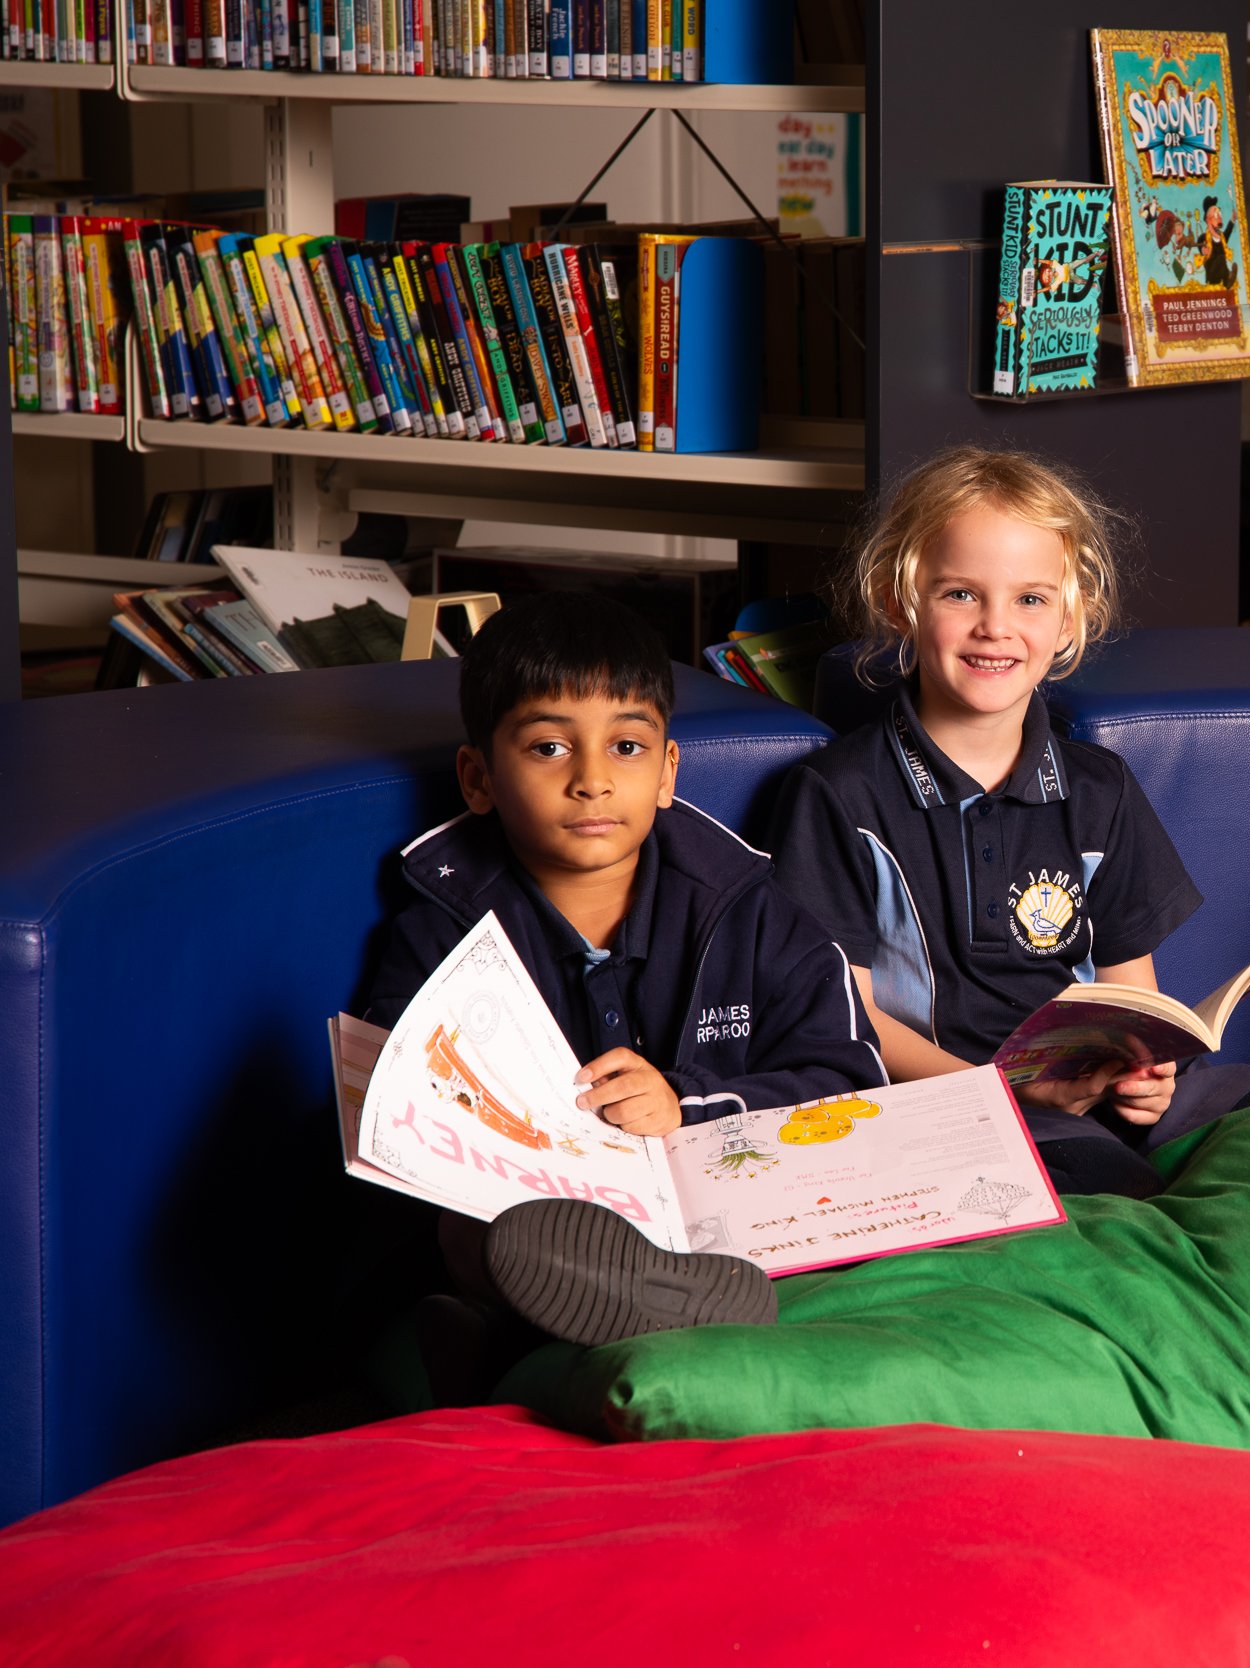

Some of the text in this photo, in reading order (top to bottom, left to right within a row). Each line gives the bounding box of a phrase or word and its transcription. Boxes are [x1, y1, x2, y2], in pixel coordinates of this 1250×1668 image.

[551, 7, 559, 40] French
[559, 8, 567, 39] Jackie
[648, 4, 656, 41] ONION
[687, 7, 696, 35] WORD
[1129, 92, 1218, 149] SPOONER
[1164, 133, 1180, 146] OR
[1149, 150, 1210, 177] LATER
[1004, 191, 1019, 258] STUNT KID
[1036, 201, 1103, 239] STUNT
[468, 251, 482, 279] JUST
[565, 254, 584, 296] MARLEY
[1033, 241, 1095, 308] KID
[382, 267, 411, 340] ANDY GRIFFITHS
[547, 251, 573, 330] HURRICANE WILLS
[1163, 298, 1227, 311] PAUL JENNINGS
[1028, 304, 1097, 336] SERIOUSLY
[1163, 310, 1233, 322] TED GREENWOOD
[1168, 321, 1230, 333] TERRY DENTON
[444, 341, 461, 366] ANDY
[643, 335, 654, 375] WOLVES
[1027, 328, 1073, 359] STACKS
[1075, 331, 1090, 350] IT!
[451, 367, 472, 413] GRIFFITHS
[306, 567, 336, 579] THE
[336, 570, 389, 583] ISLAND
[904, 747, 936, 796] JAMES
[1042, 768, 1058, 792] ST.
[1008, 869, 1083, 908] ST JAMES
[1016, 936, 1026, 946] and
[1025, 945, 1036, 954] ACT
[1048, 941, 1067, 954] HEART
[1066, 933, 1076, 945] and
[698, 1004, 750, 1025] JAMES
[391, 1100, 653, 1224] BARNEY
[750, 1185, 940, 1232] STEPHEN MICHAEL KING
[748, 1210, 942, 1258] CATHERINE JINKS
